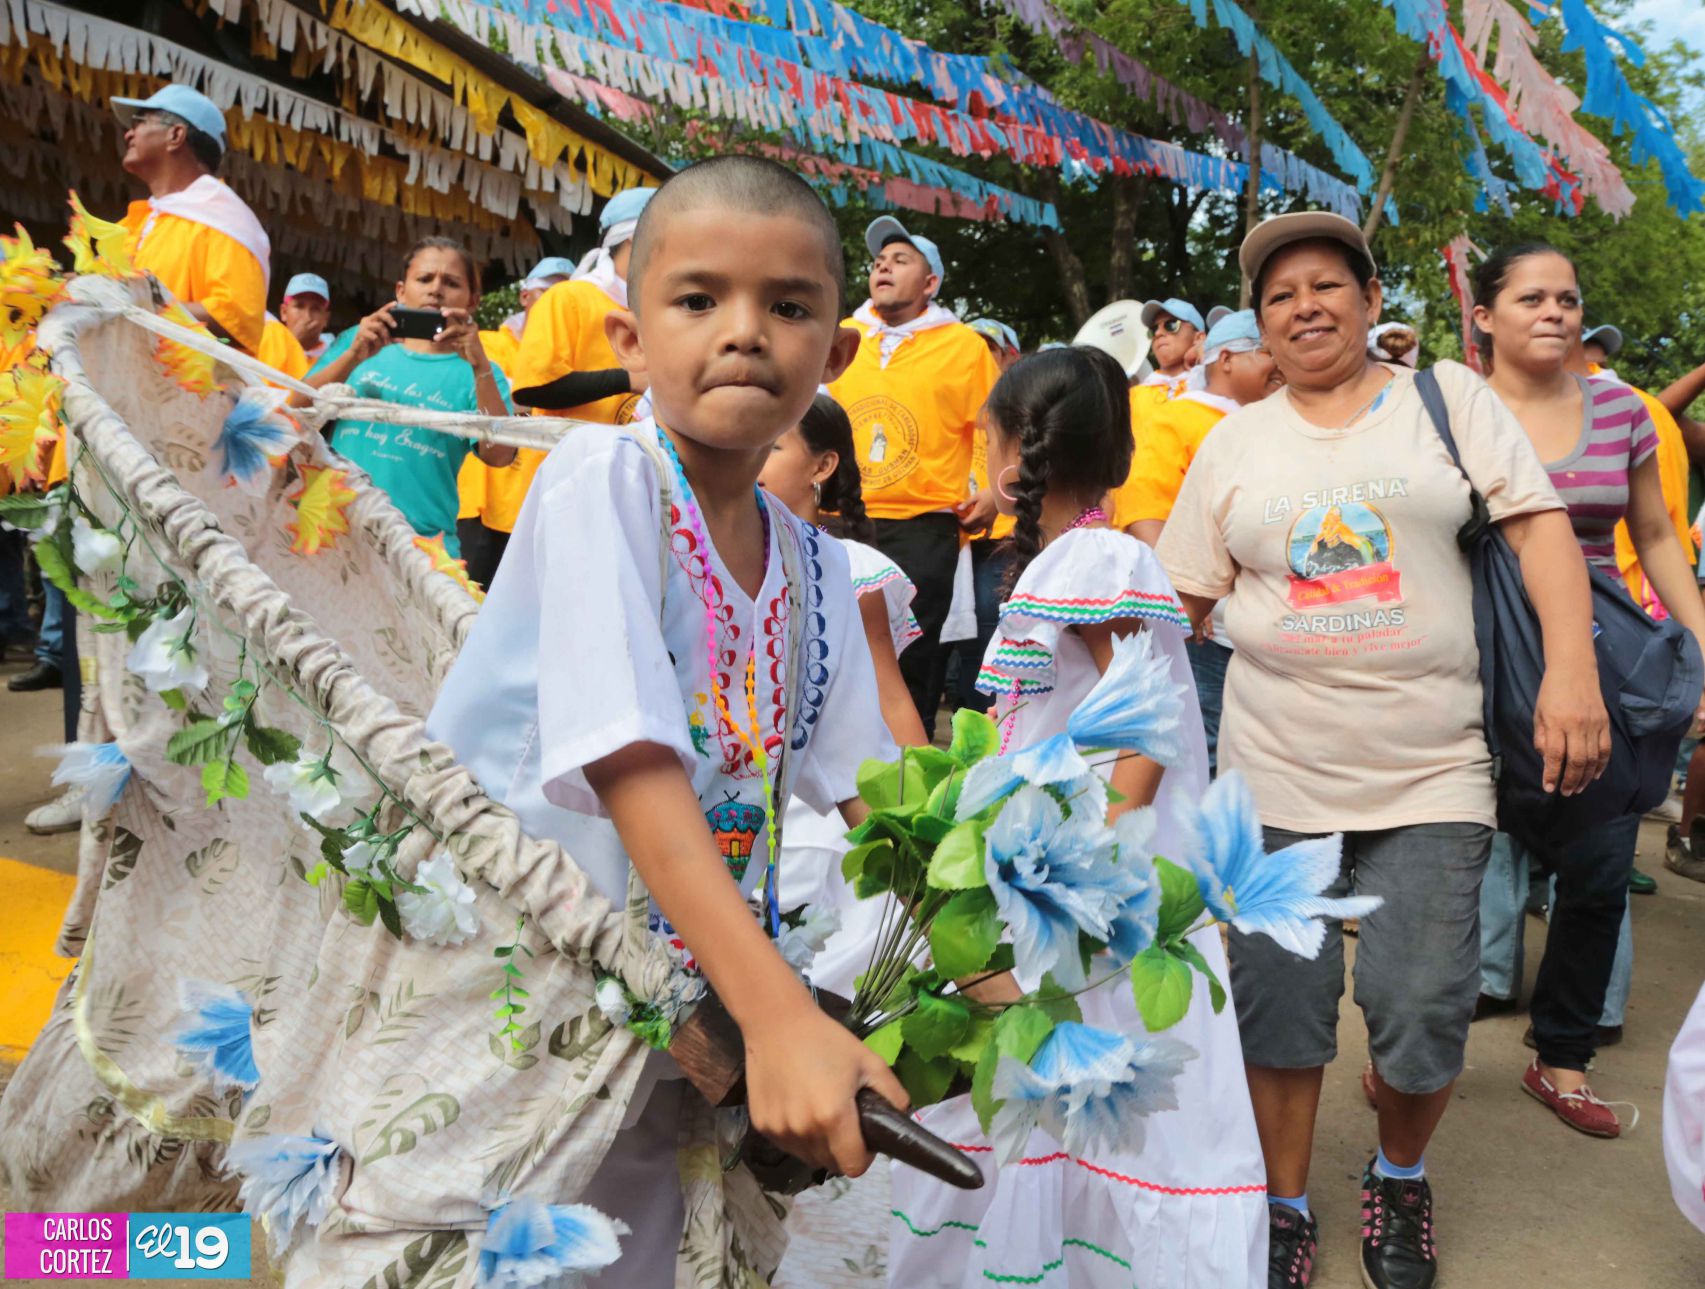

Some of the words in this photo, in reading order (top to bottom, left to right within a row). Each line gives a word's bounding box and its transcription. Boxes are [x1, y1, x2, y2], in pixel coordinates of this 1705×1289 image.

[1263, 494, 1291, 525] LA
[1302, 478, 1407, 510] SIRENA
[1282, 608, 1405, 633] SARDINAS
